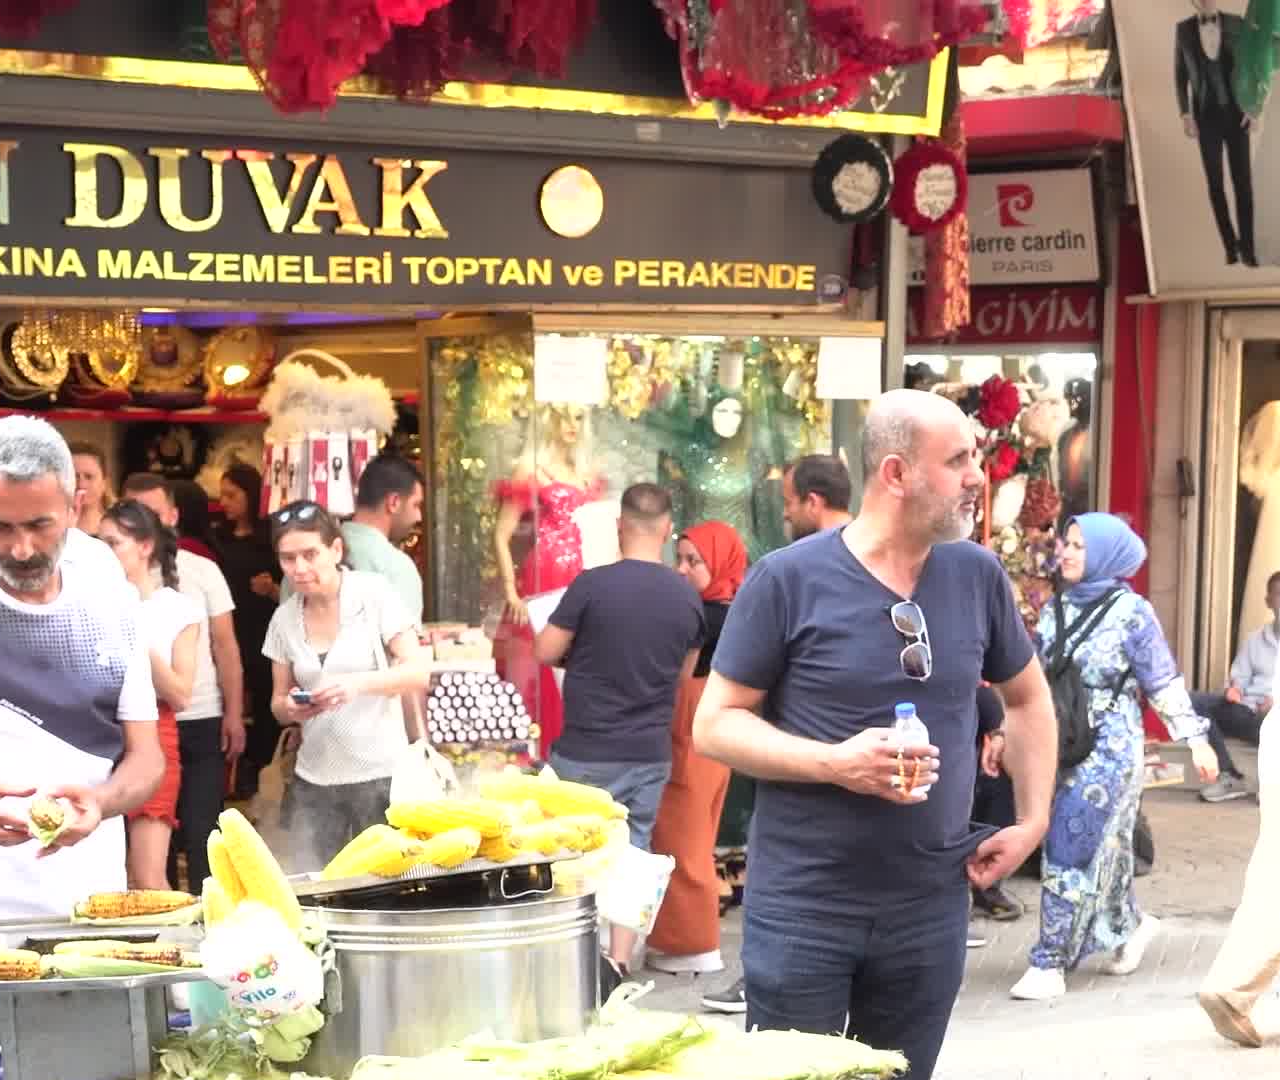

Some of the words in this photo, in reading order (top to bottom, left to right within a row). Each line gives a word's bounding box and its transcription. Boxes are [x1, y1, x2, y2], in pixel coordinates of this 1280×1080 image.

[61, 141, 450, 240] DUVAK
[967, 235, 1016, 254] ierre
[1021, 229, 1086, 251] cardin
[96, 248, 393, 285] MALZEMELERİ
[402, 256, 553, 286] TOPTAN
[562, 265, 603, 287] ve
[613, 258, 817, 291] PERAKENDE
[975, 288, 1097, 337] GİYİM
